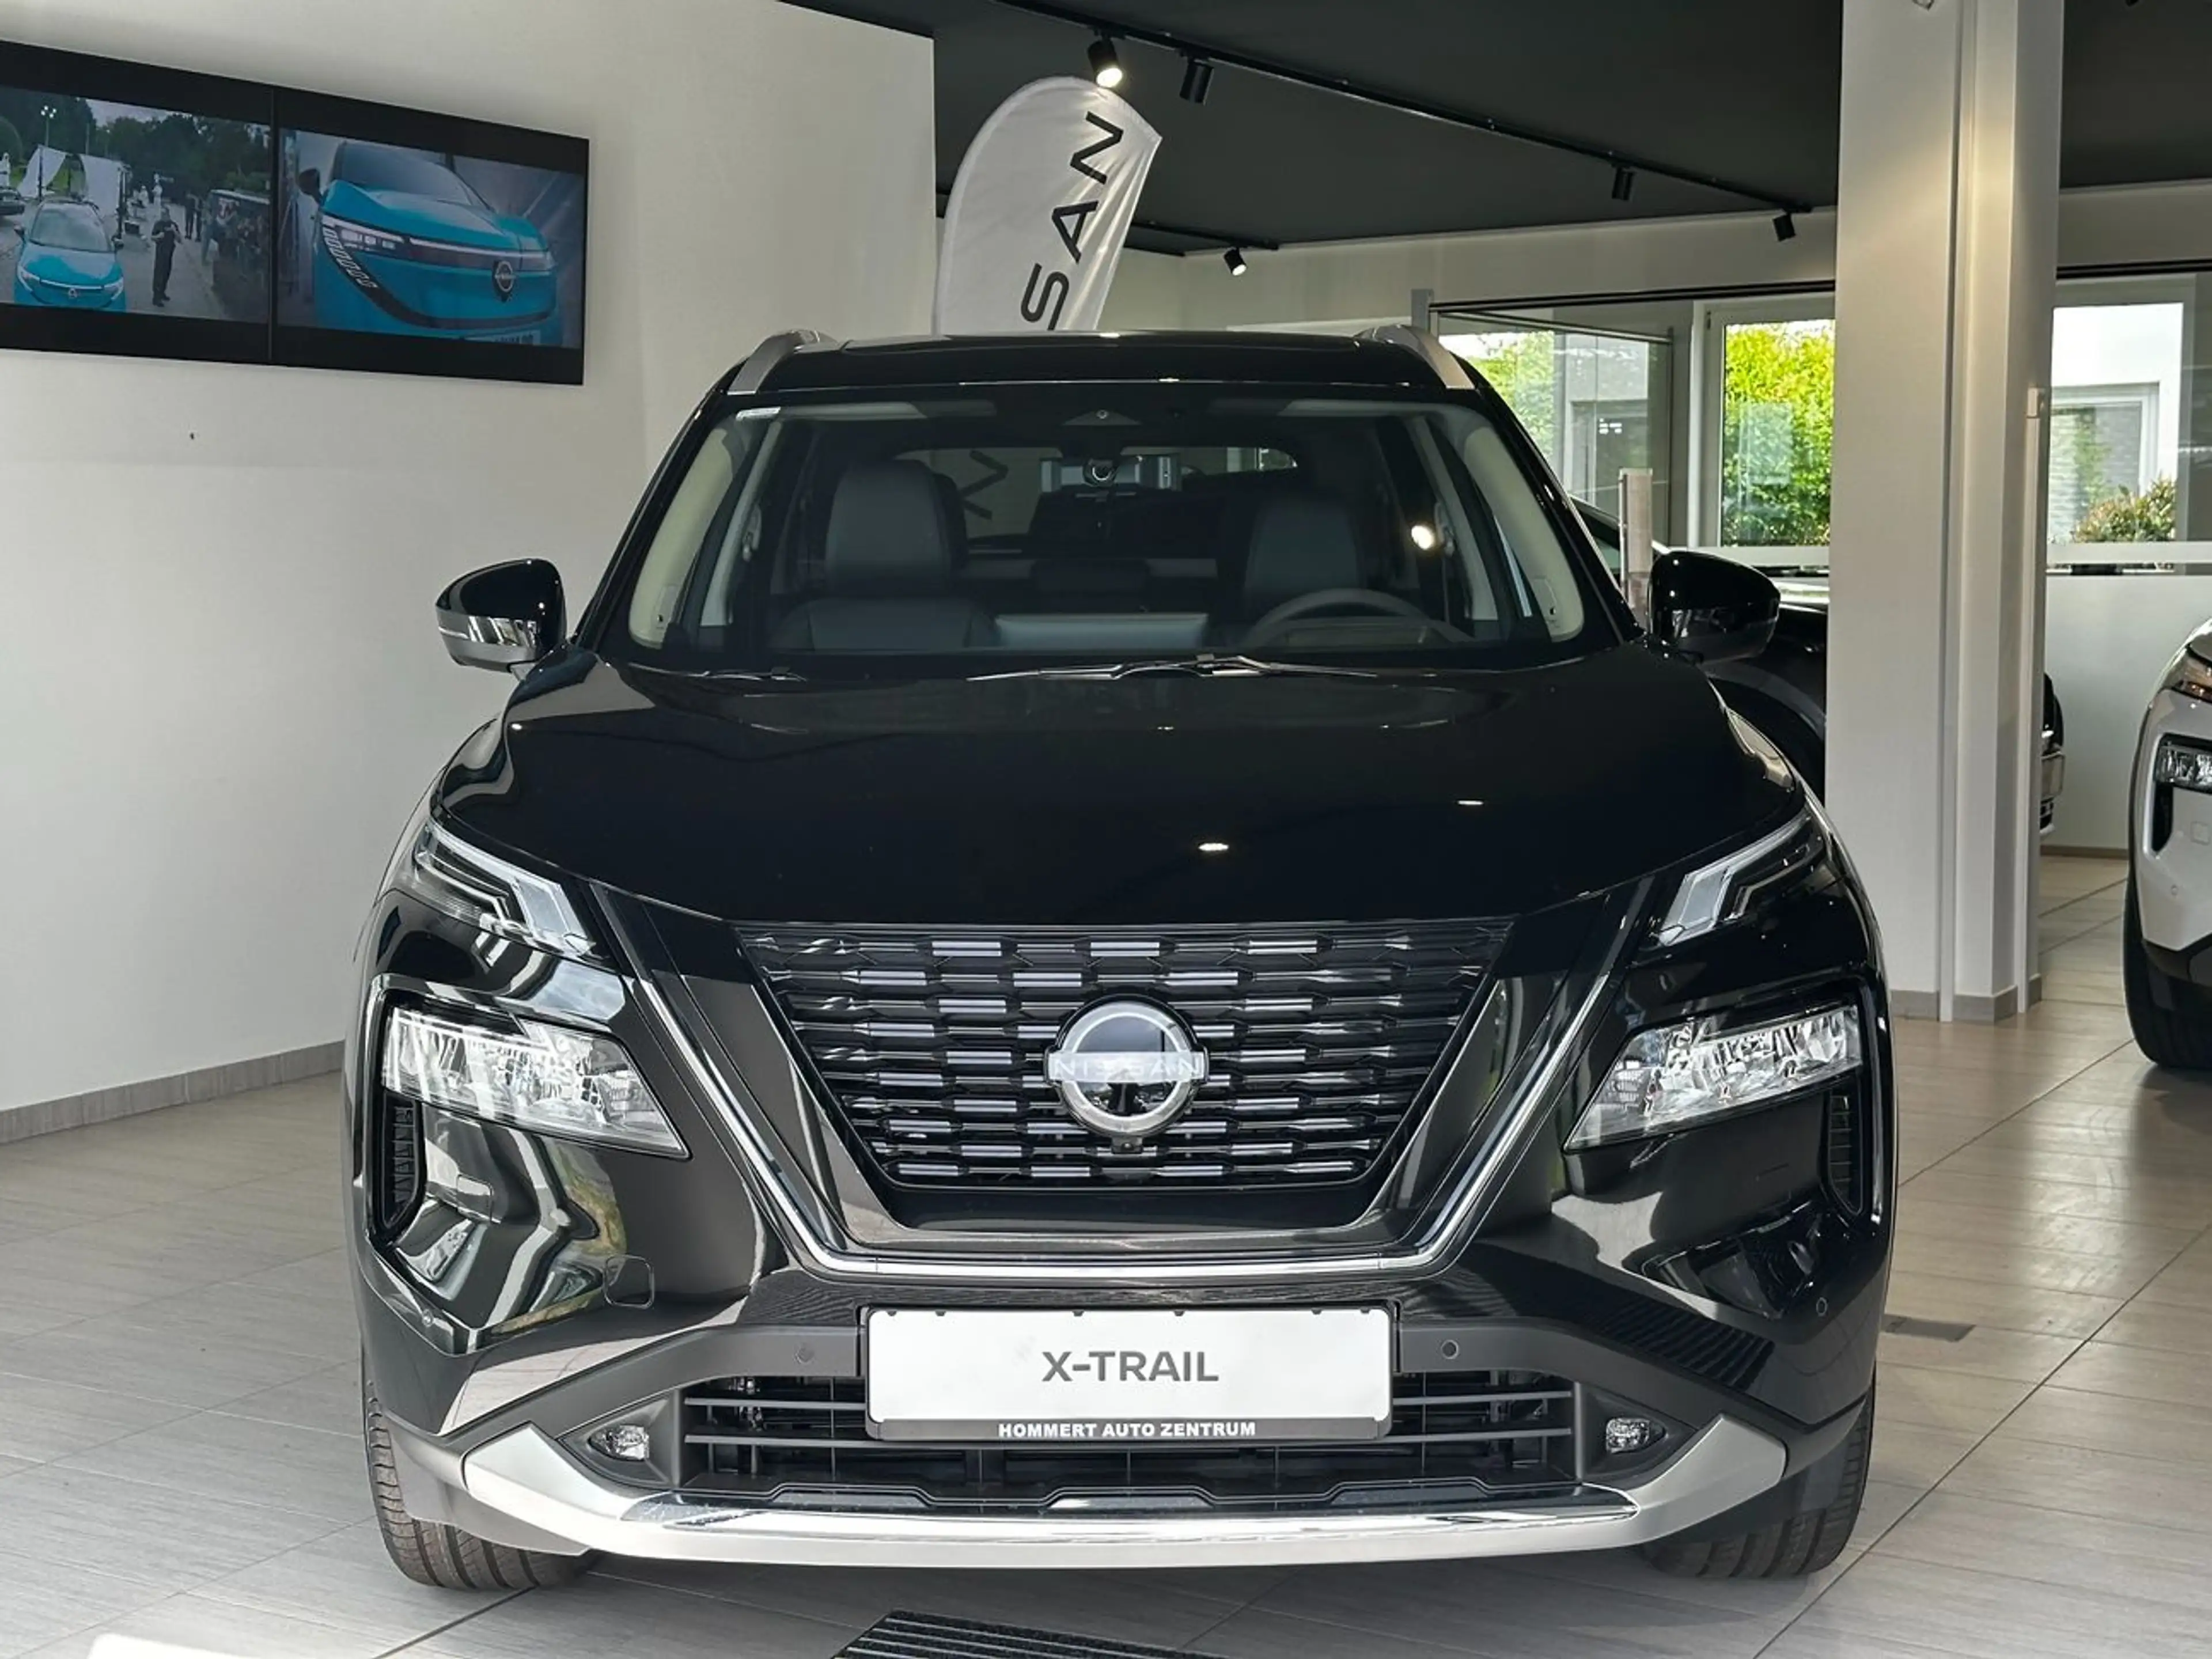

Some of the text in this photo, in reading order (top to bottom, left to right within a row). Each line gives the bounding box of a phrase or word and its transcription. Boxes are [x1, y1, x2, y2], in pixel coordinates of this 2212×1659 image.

[1041, 1351, 1219, 1381] X-TRAIL
[998, 1422, 1256, 1438] HOMMERT AUTO ZENTRUM
